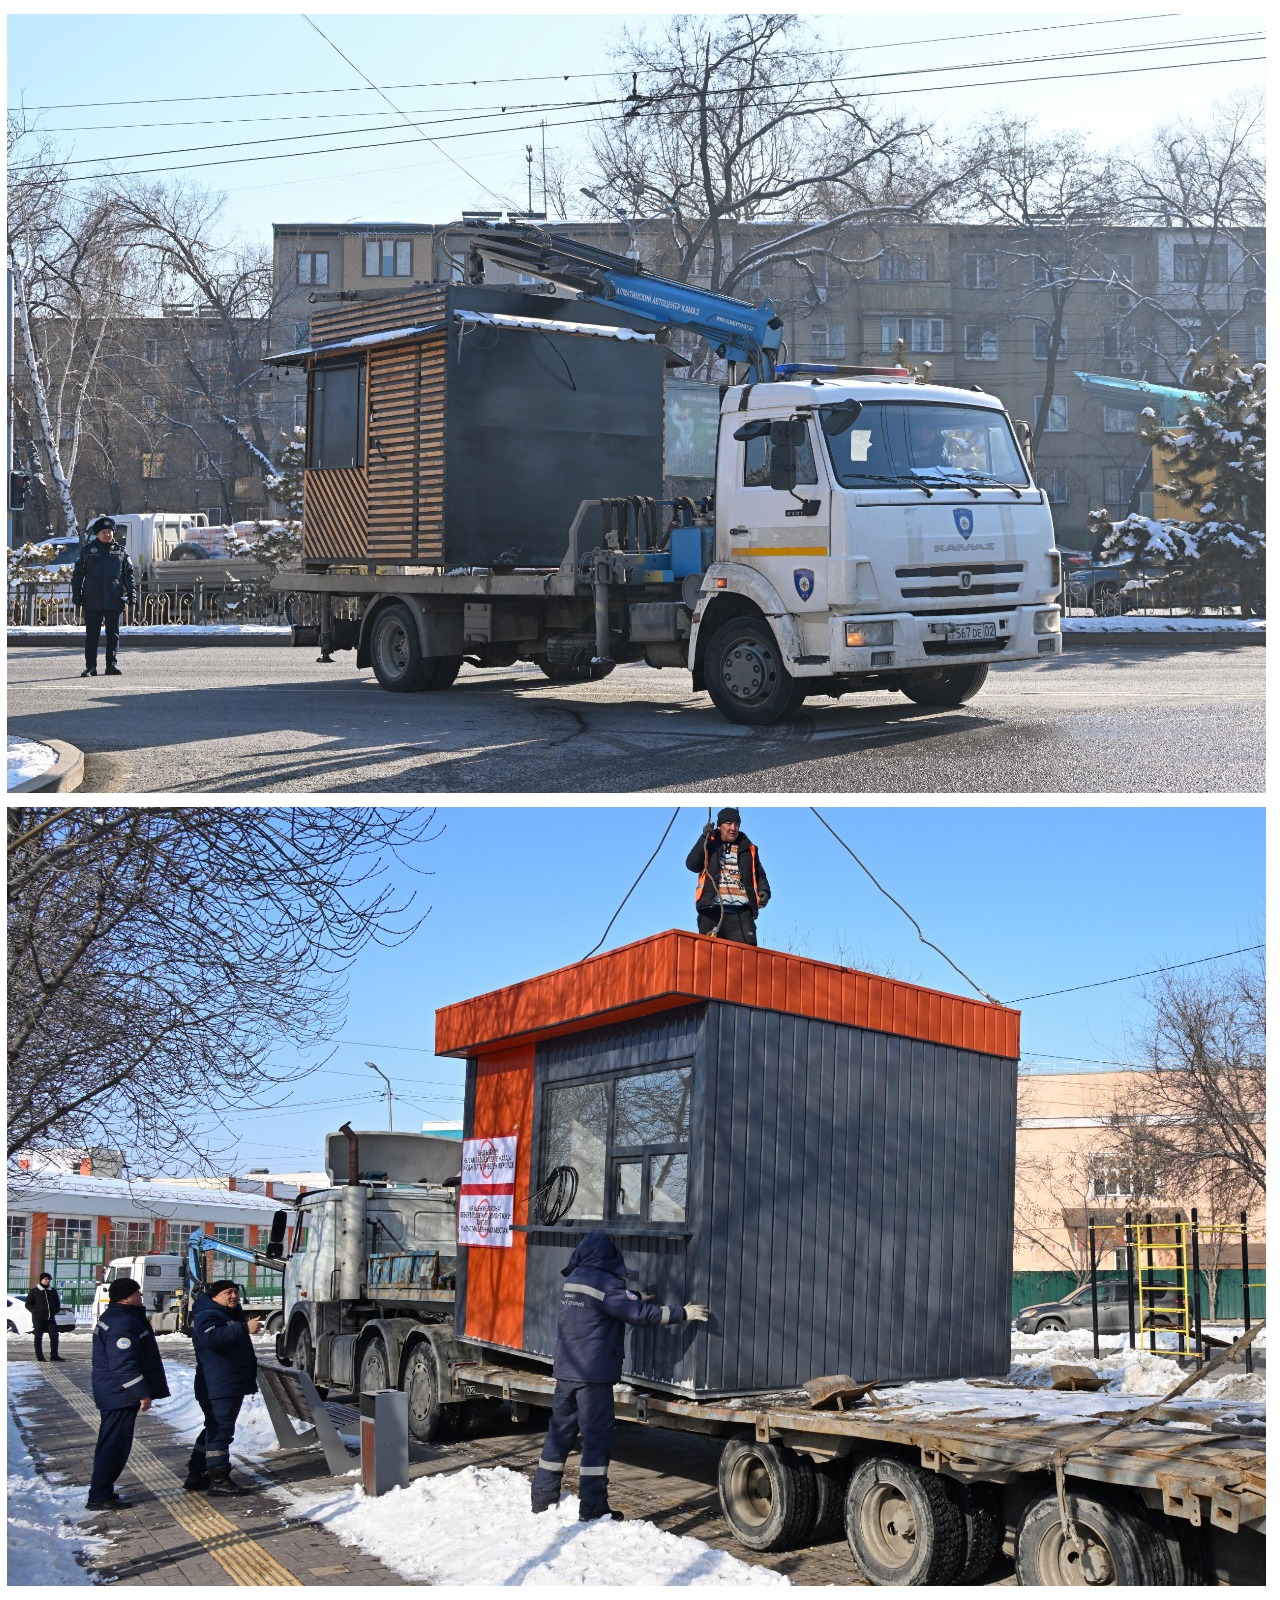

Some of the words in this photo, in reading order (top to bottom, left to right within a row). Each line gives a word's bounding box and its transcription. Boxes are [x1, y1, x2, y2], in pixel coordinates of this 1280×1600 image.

[956, 627, 971, 639] 567
[972, 628, 982, 638] DE
[984, 625, 995, 637] 02
